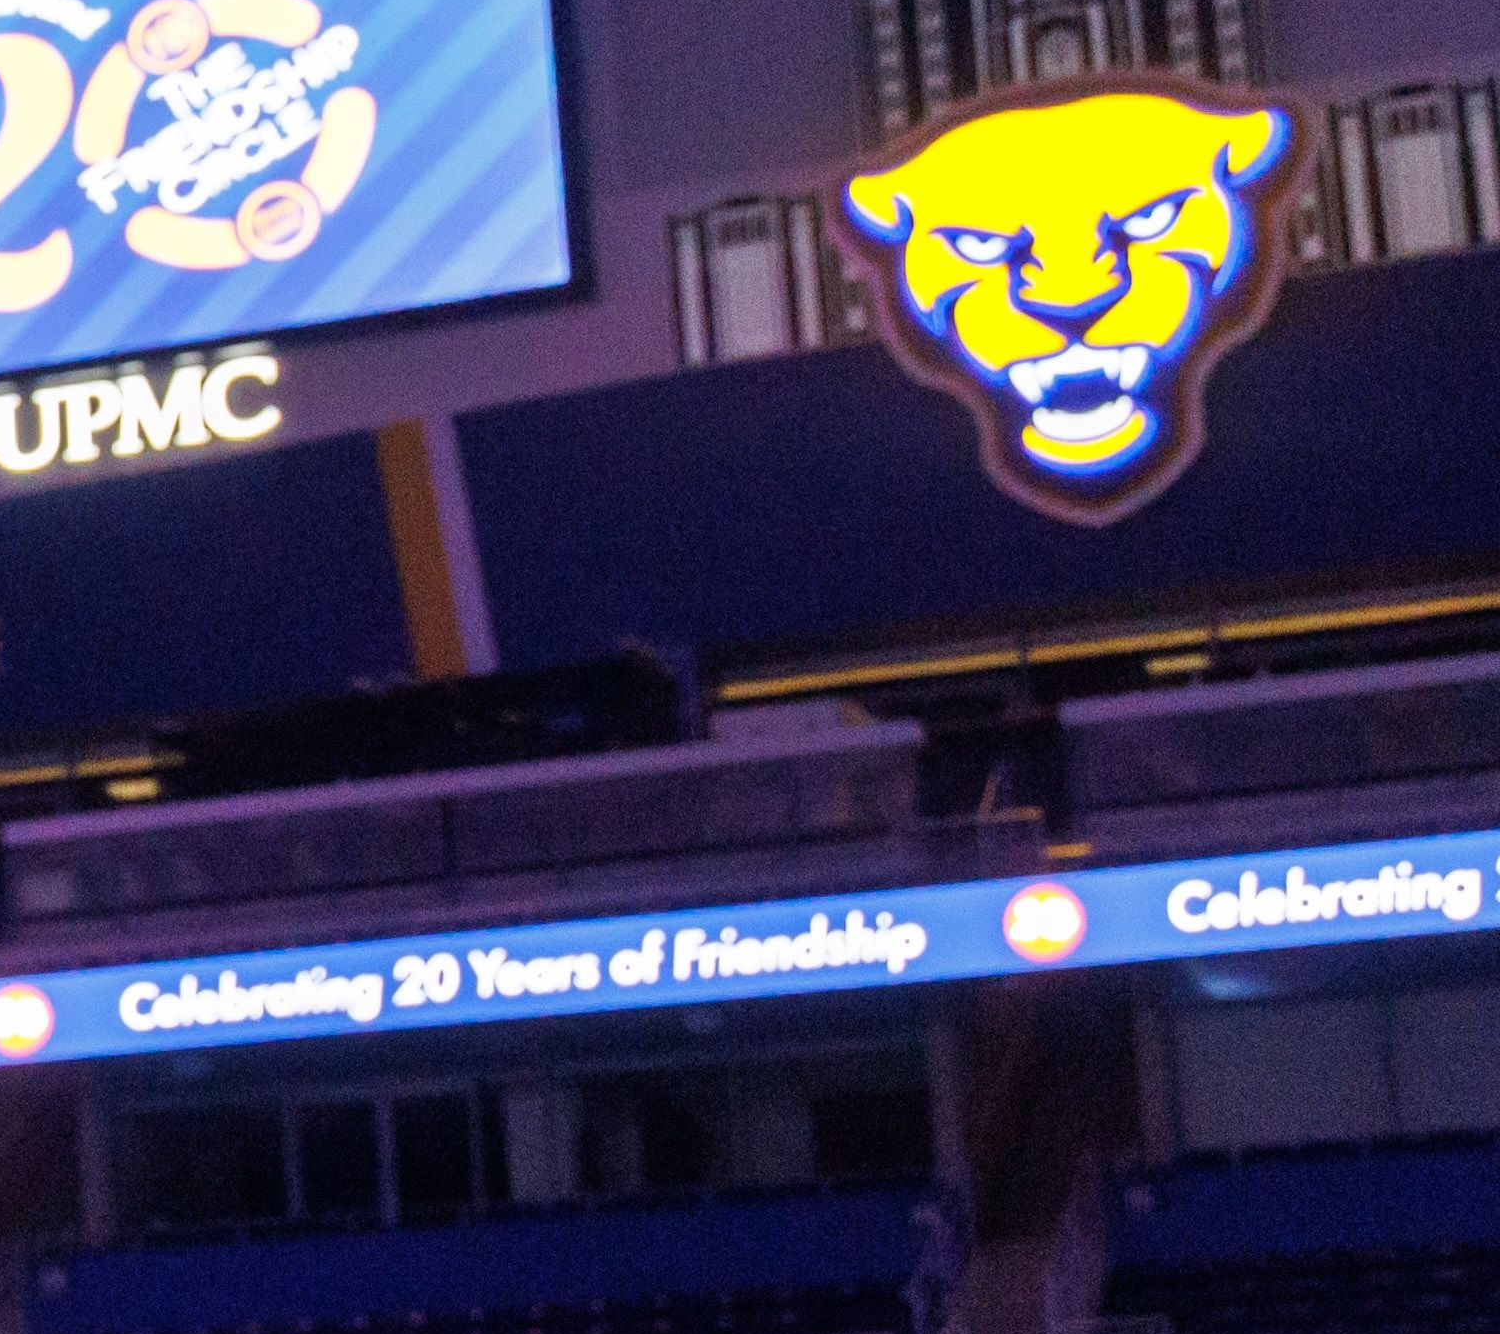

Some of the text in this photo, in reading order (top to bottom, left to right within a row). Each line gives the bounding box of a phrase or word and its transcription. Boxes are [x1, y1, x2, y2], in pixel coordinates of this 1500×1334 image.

[146, 42, 255, 121] THE
[157, 97, 321, 214] CIRCLE
[1167, 860, 1482, 933] Celebrating
[120, 910, 927, 1024] Celebrating 20 Years of Friendship
